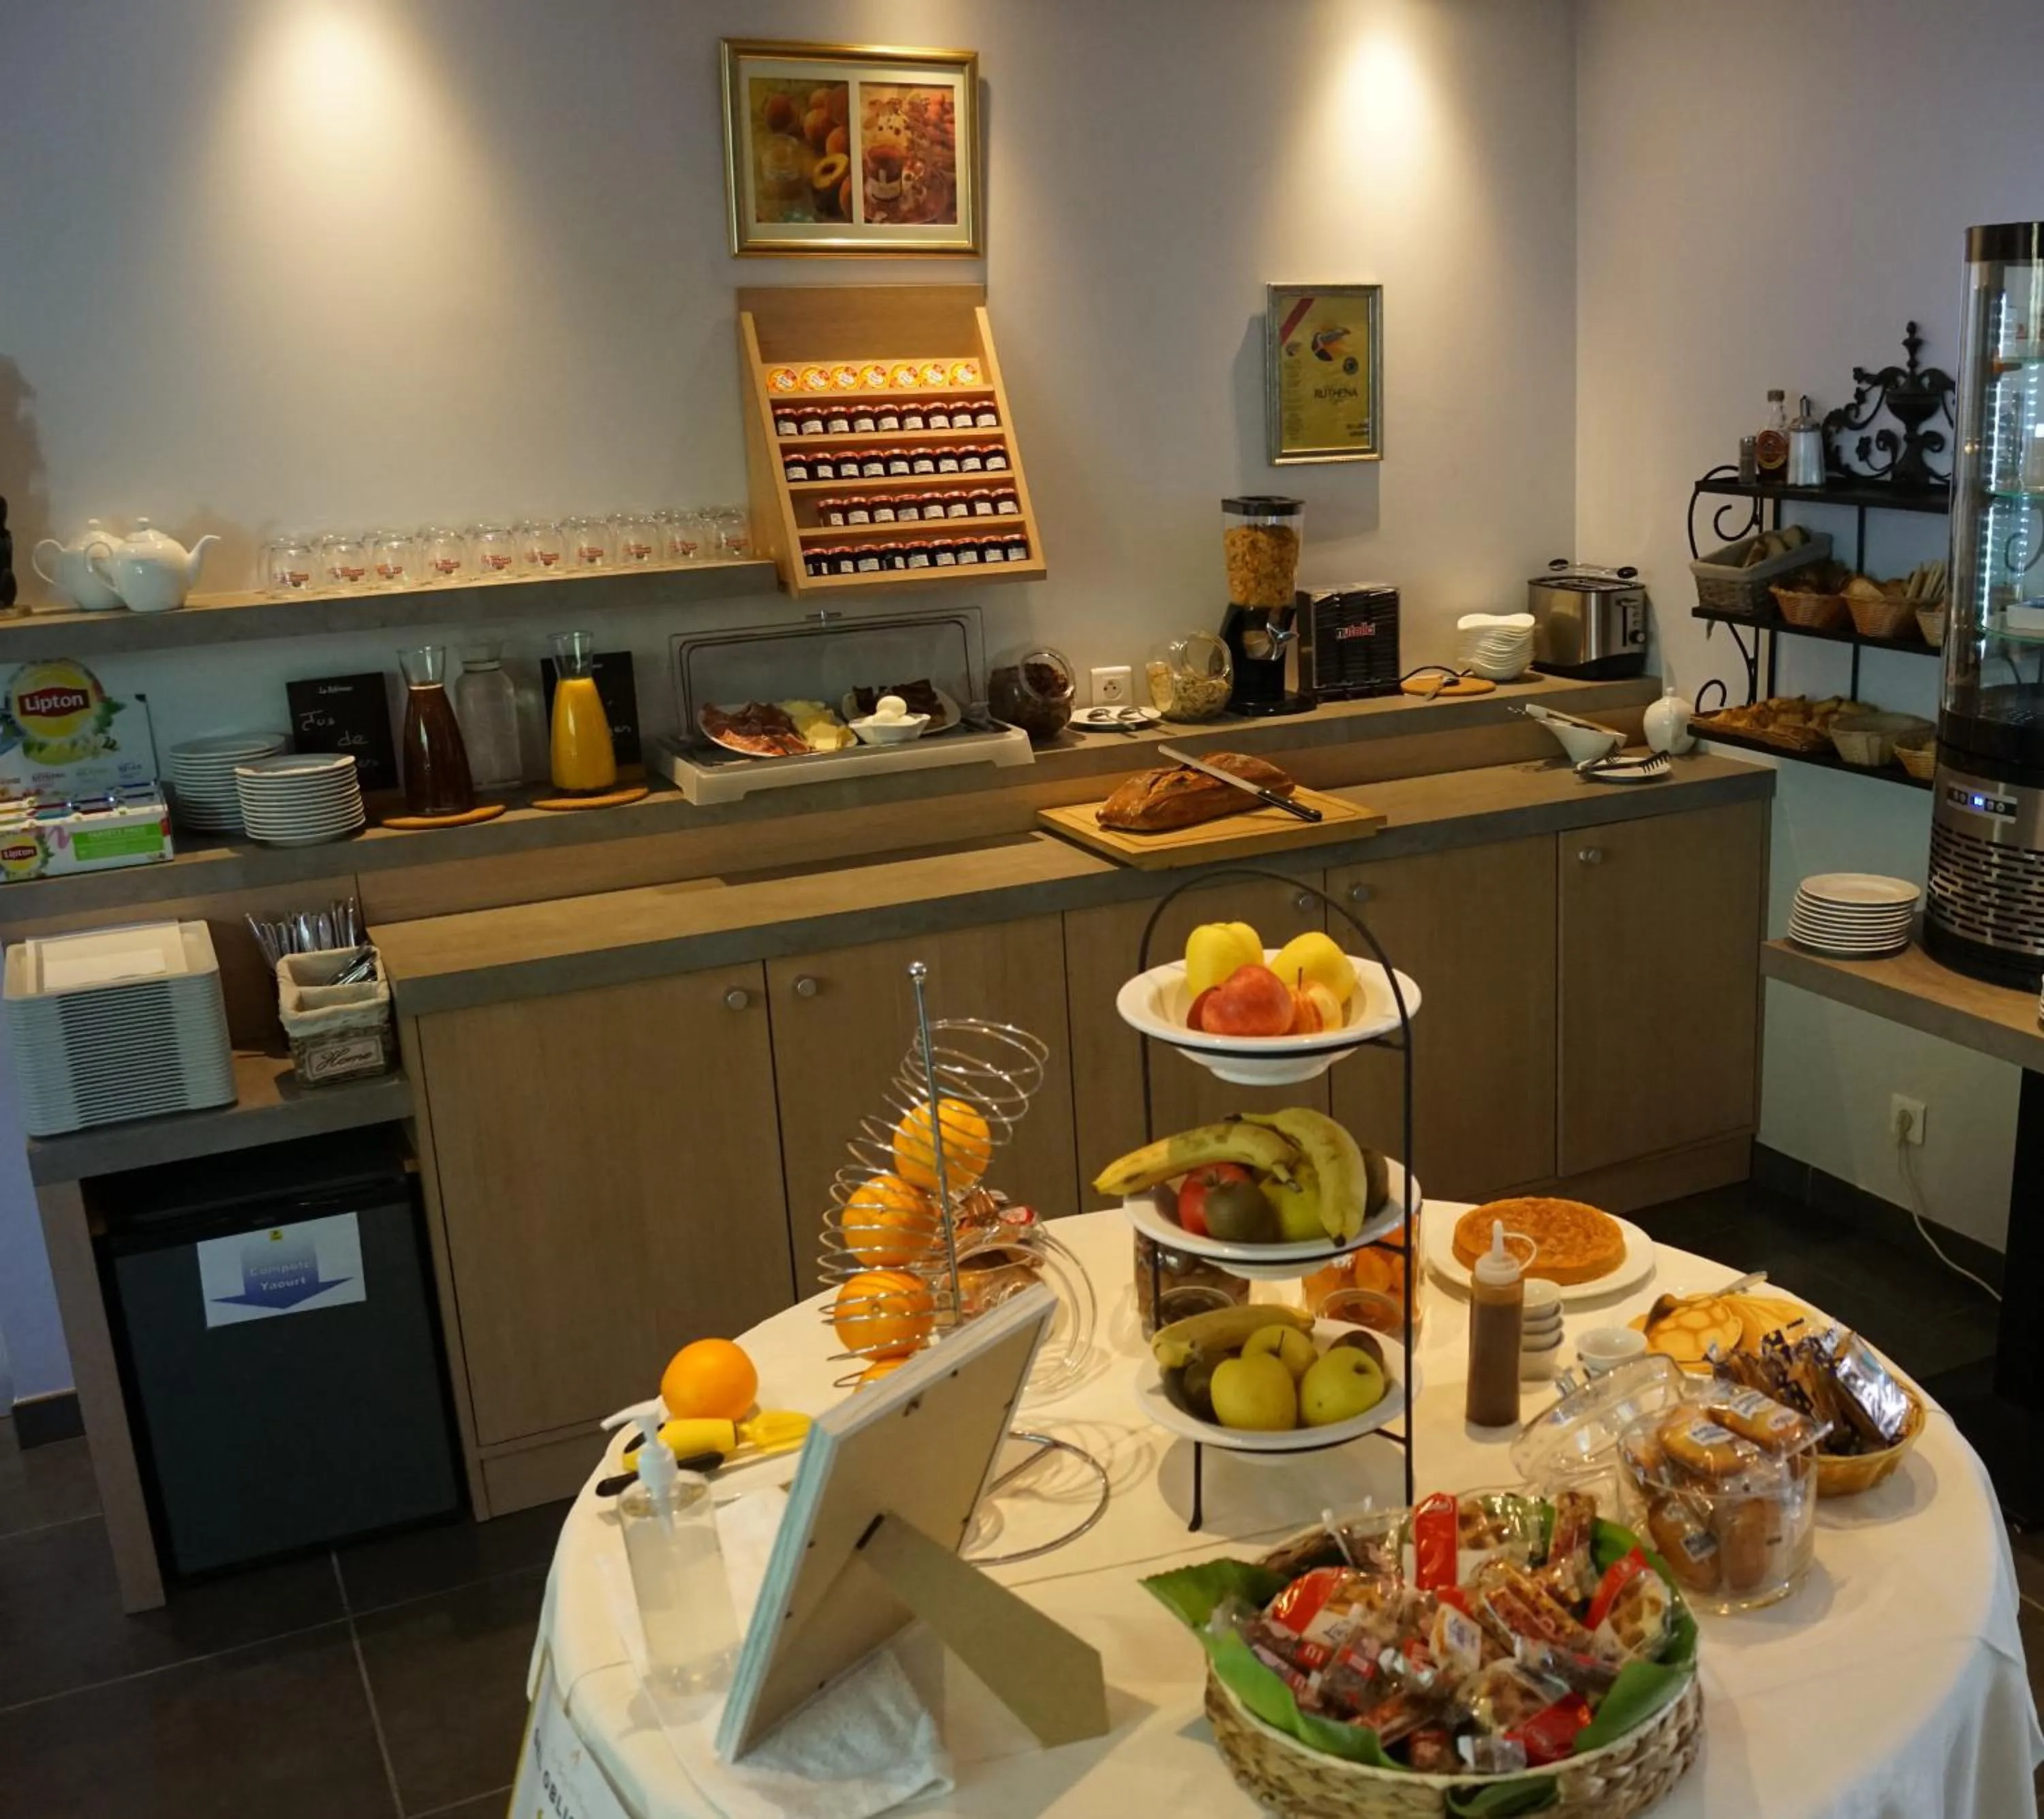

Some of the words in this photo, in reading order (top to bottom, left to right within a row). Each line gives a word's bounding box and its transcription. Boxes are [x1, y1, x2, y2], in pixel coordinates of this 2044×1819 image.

[25, 692, 84, 713] Lipton
[3, 848, 35, 860] Lipton
[260, 1275, 307, 1292] Yaourt
